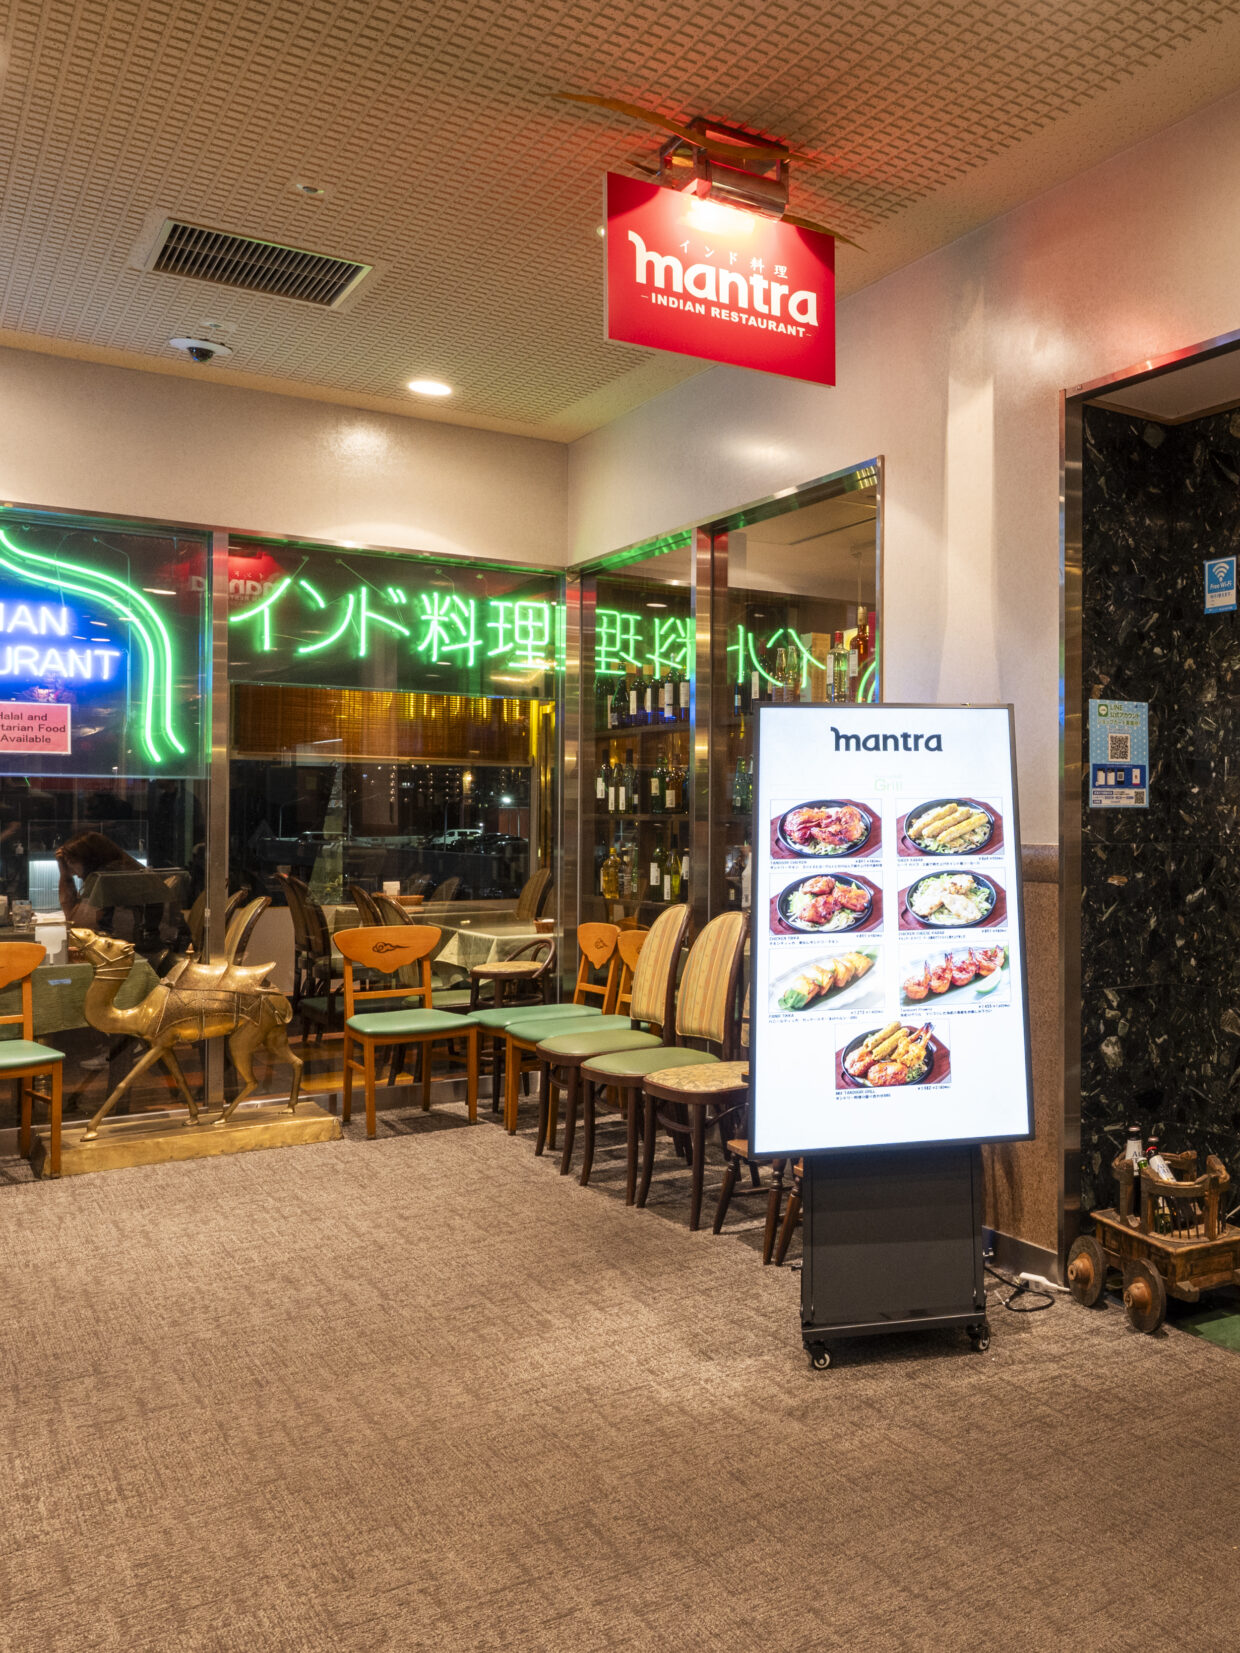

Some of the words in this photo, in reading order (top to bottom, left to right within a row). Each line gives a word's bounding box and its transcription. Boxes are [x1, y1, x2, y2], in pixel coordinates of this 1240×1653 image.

[680, 240, 788, 279] インド料理
[628, 230, 819, 326] mantra
[651, 293, 706, 315] INDIAN
[711, 308, 806, 337] RESTAURANT
[229, 577, 551, 670] インド料理
[27, 713, 48, 721] and
[38, 724, 66, 733] Food
[0, 734, 51, 744] Available
[830, 726, 943, 752] mantra
